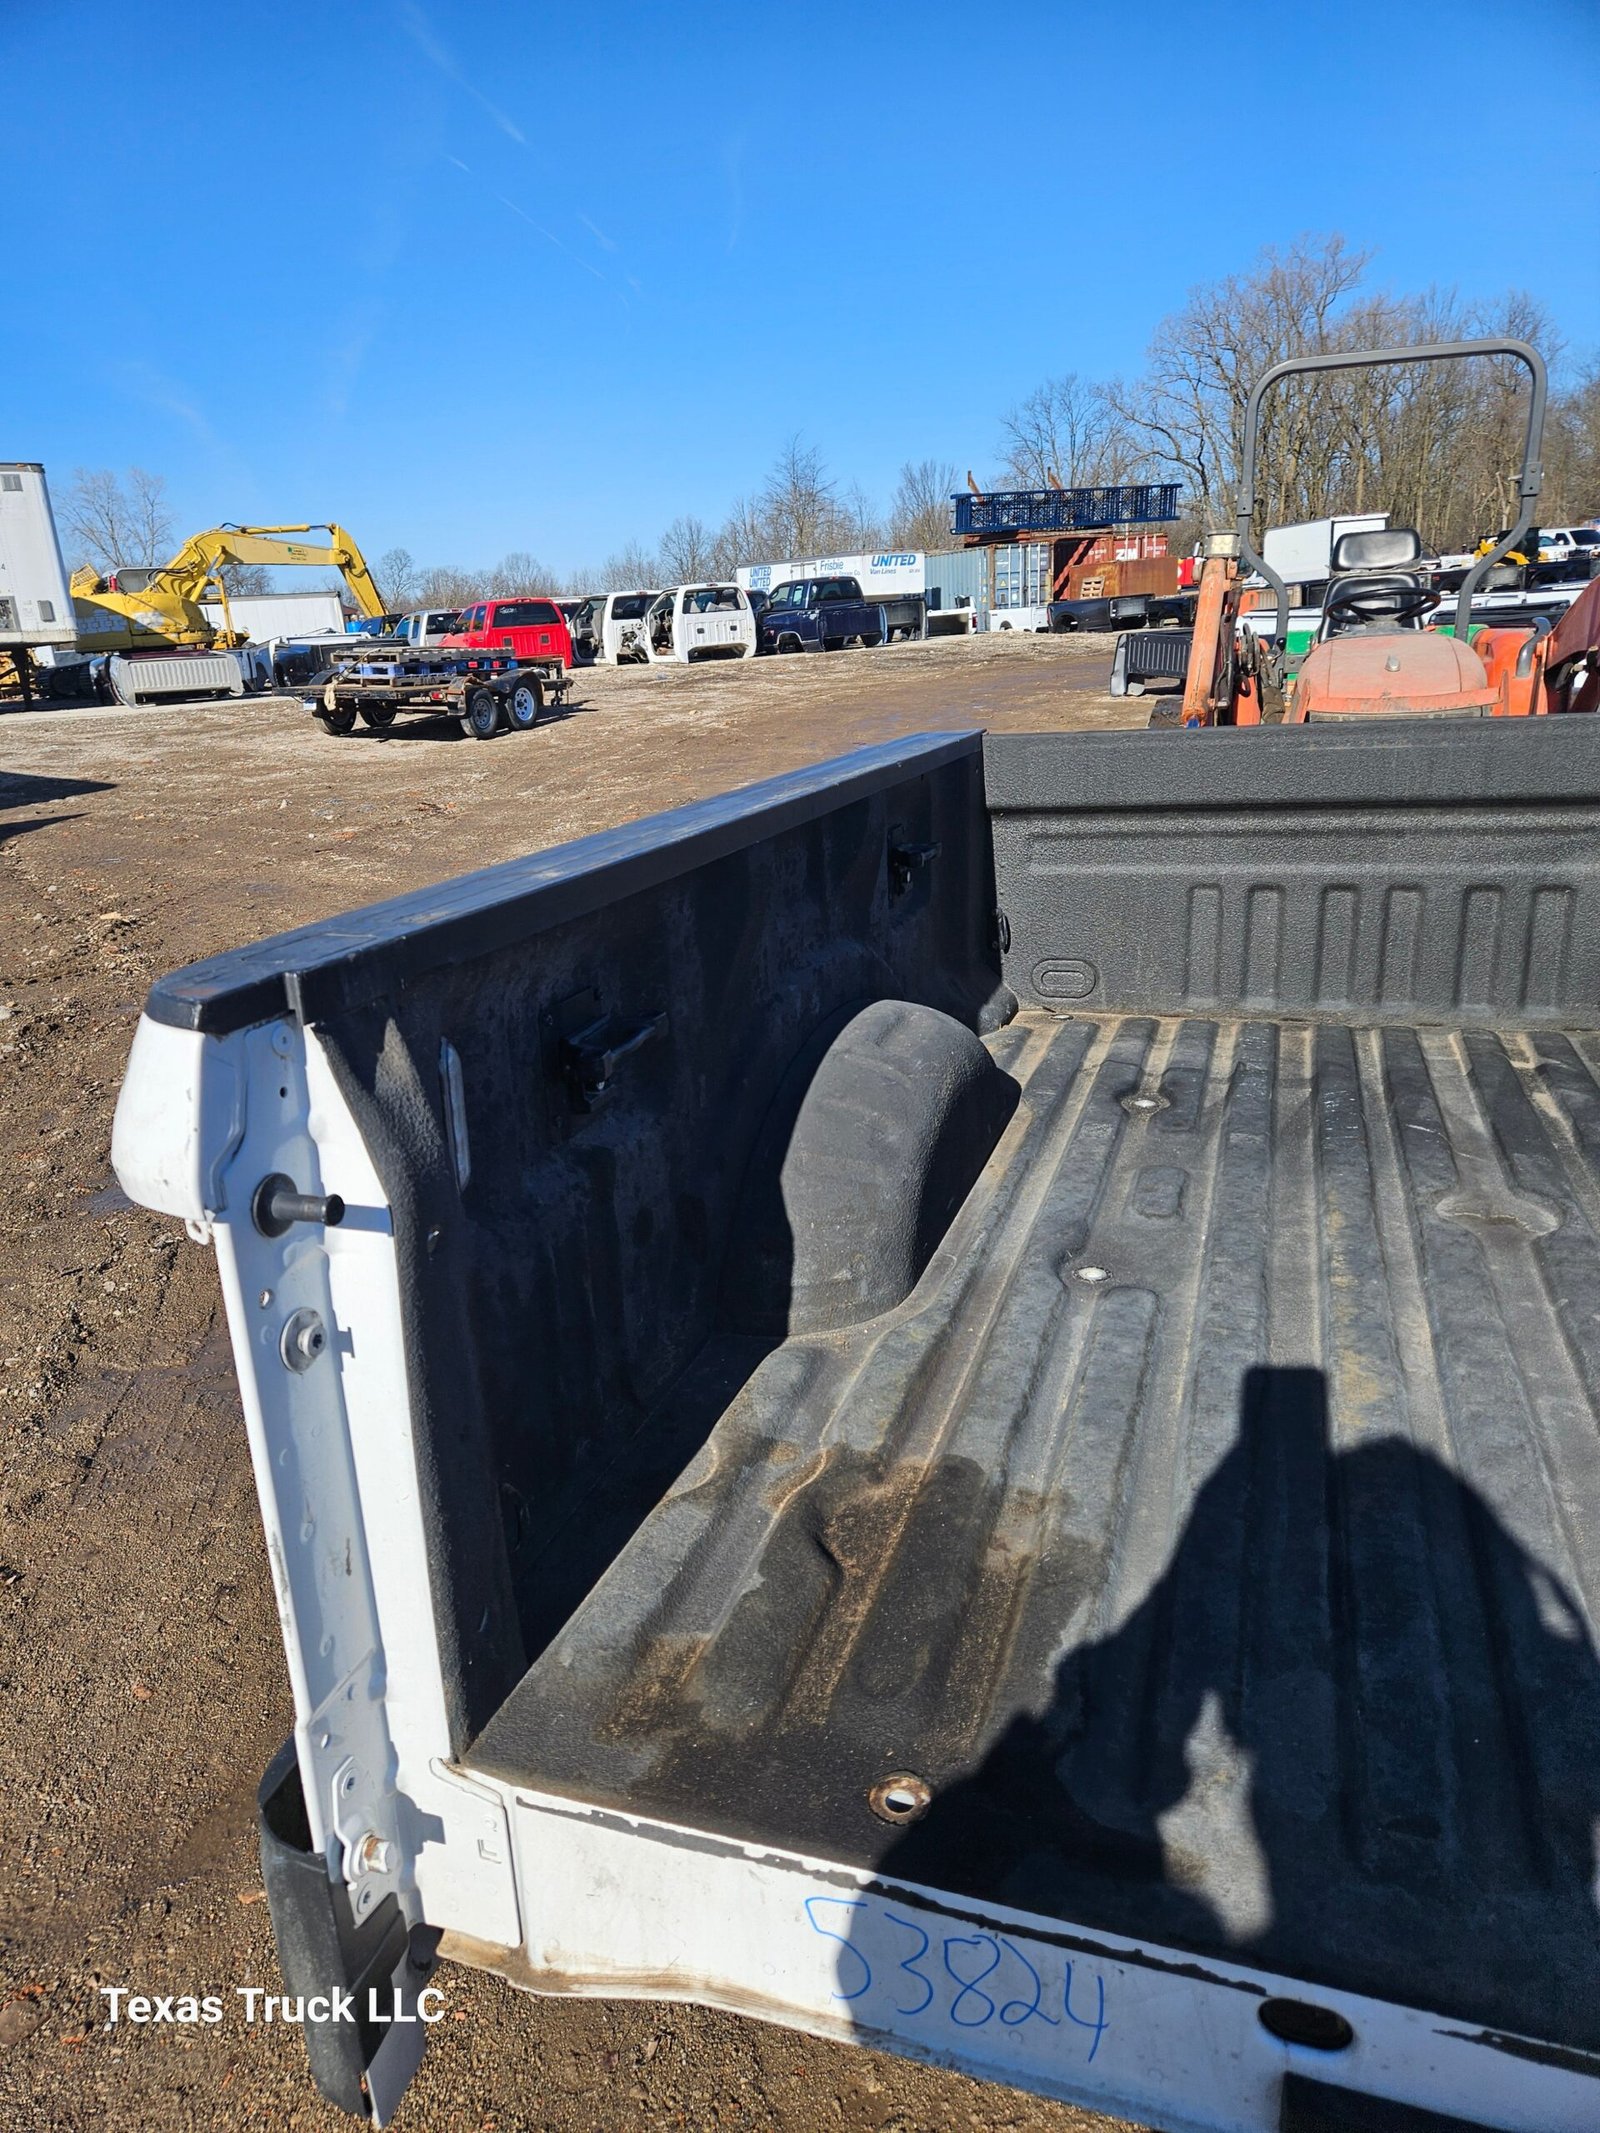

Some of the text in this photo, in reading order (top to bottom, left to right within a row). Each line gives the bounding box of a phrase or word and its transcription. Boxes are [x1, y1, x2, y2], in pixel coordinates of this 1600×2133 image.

[1115, 548, 1138, 560] ZIM
[871, 554, 917, 567] UNITED
[749, 566, 772, 578] UNITED
[869, 567, 897, 575] Van Lines
[749, 577, 771, 588] UNITED
[805, 1896, 1109, 2063] 53824
